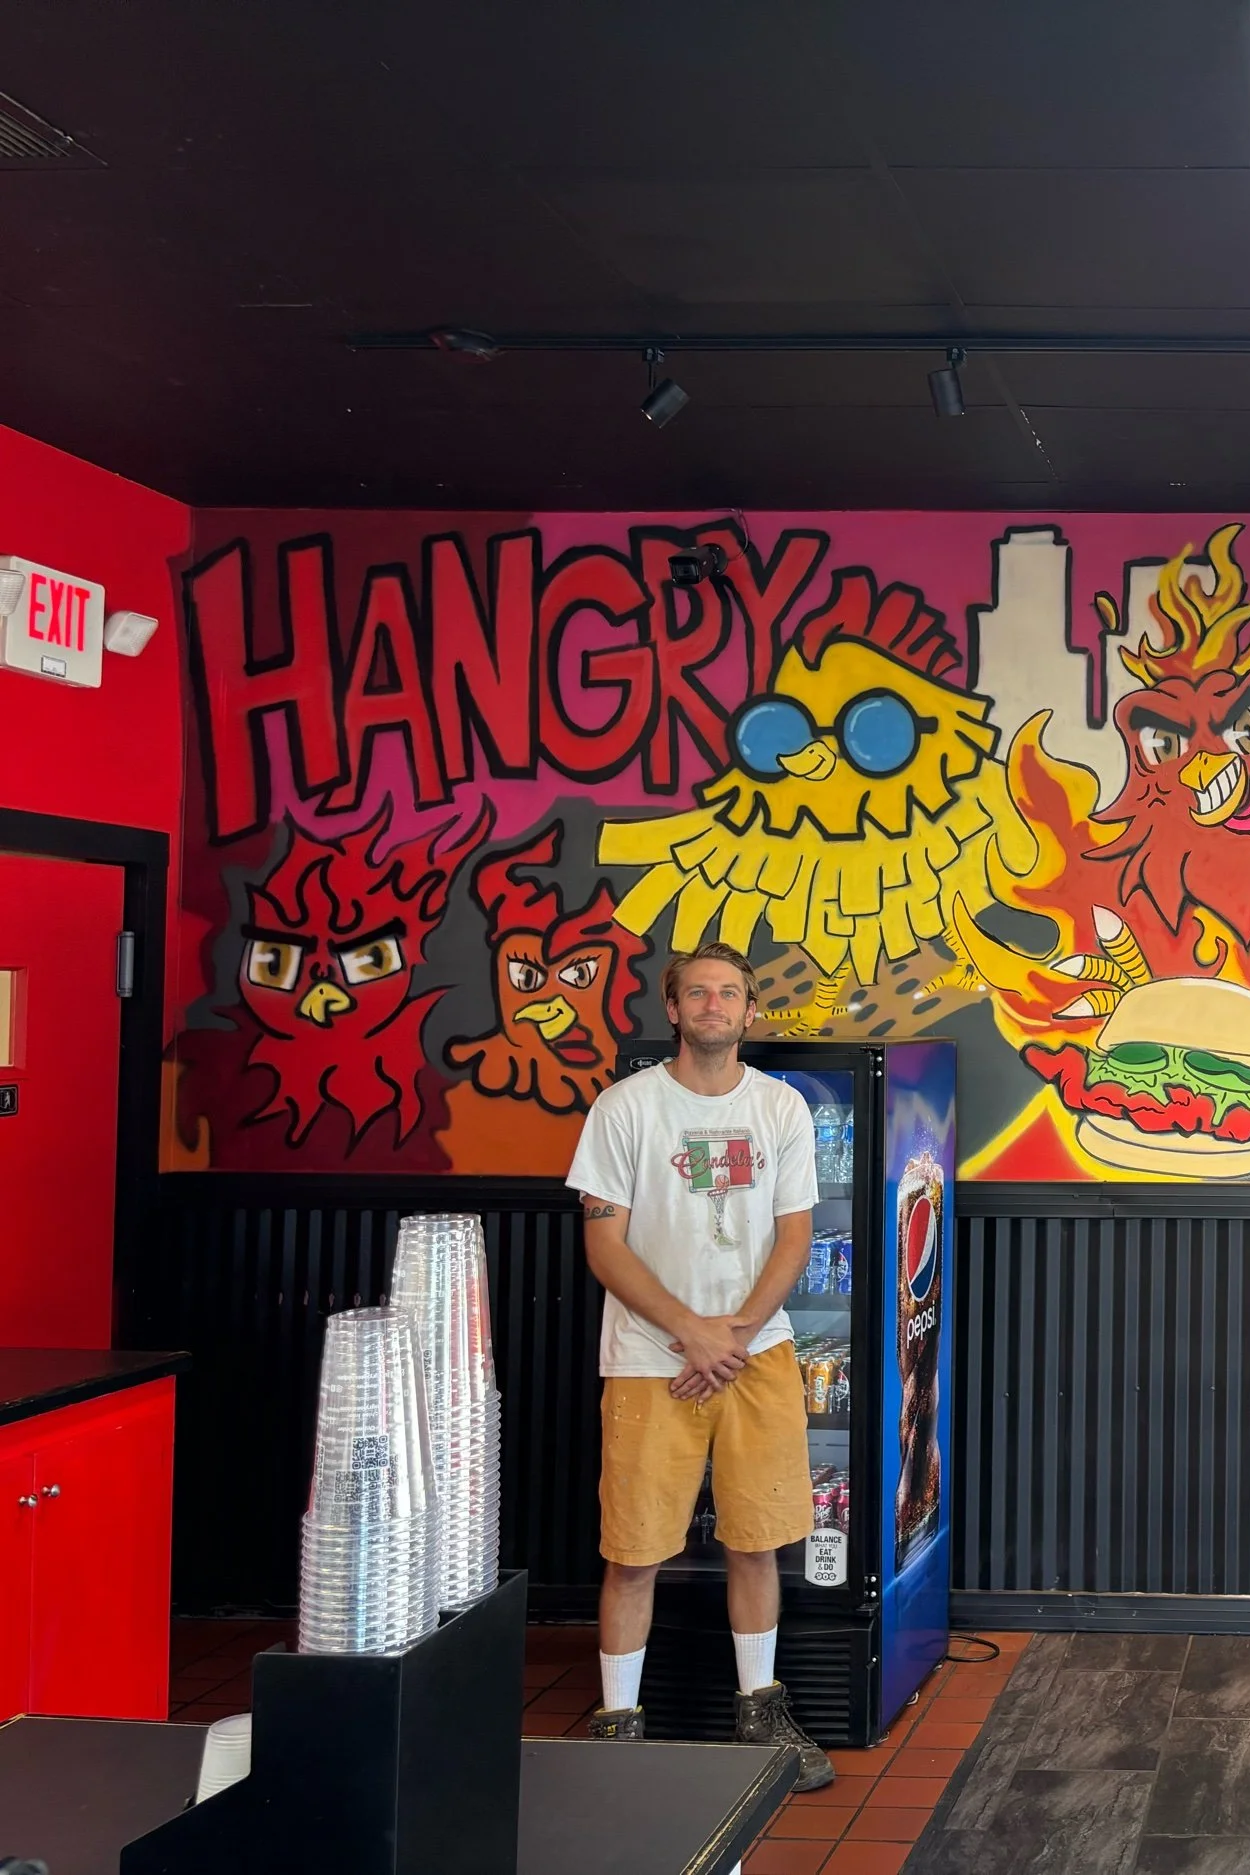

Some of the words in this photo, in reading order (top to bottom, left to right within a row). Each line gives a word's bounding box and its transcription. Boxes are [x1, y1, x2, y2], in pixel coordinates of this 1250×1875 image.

[28, 572, 91, 652] EXIT
[184, 520, 830, 846] HANGRY
[670, 1146, 765, 1179] Candela's
[906, 1299, 936, 1350] pepsi
[810, 1535, 842, 1544] BALANCE
[815, 1555, 837, 1564] DRINK
[819, 1548, 832, 1556] EAT
[817, 1563, 823, 1571] &
[823, 1563, 834, 1571] DO
